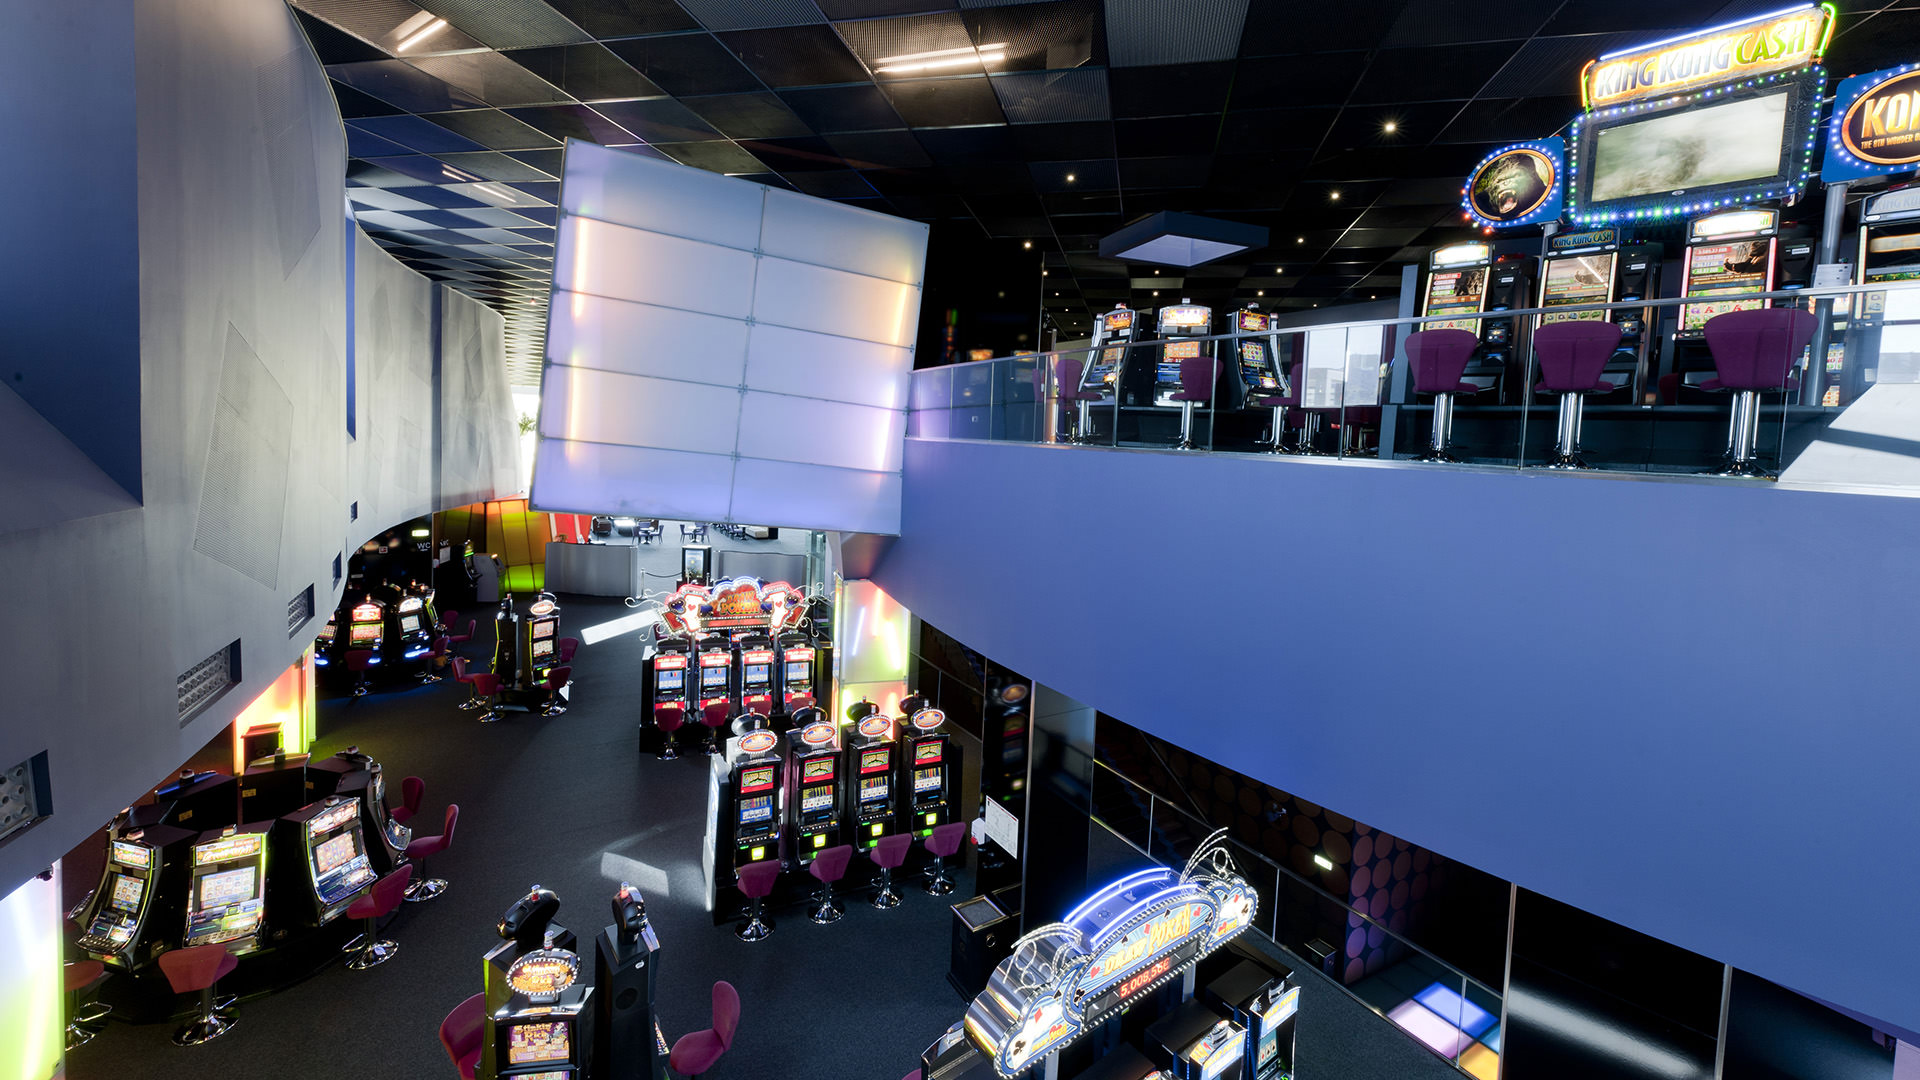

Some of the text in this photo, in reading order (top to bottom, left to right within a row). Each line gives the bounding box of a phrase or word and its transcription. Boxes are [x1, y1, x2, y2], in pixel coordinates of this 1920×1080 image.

[1597, 57, 1656, 97] KING
[1659, 37, 1731, 82] KONG
[1554, 236, 1571, 247] KING
[727, 591, 755, 603] DRAW
[720, 601, 760, 616] POKER
[1103, 903, 1191, 976] DRAW POKER
